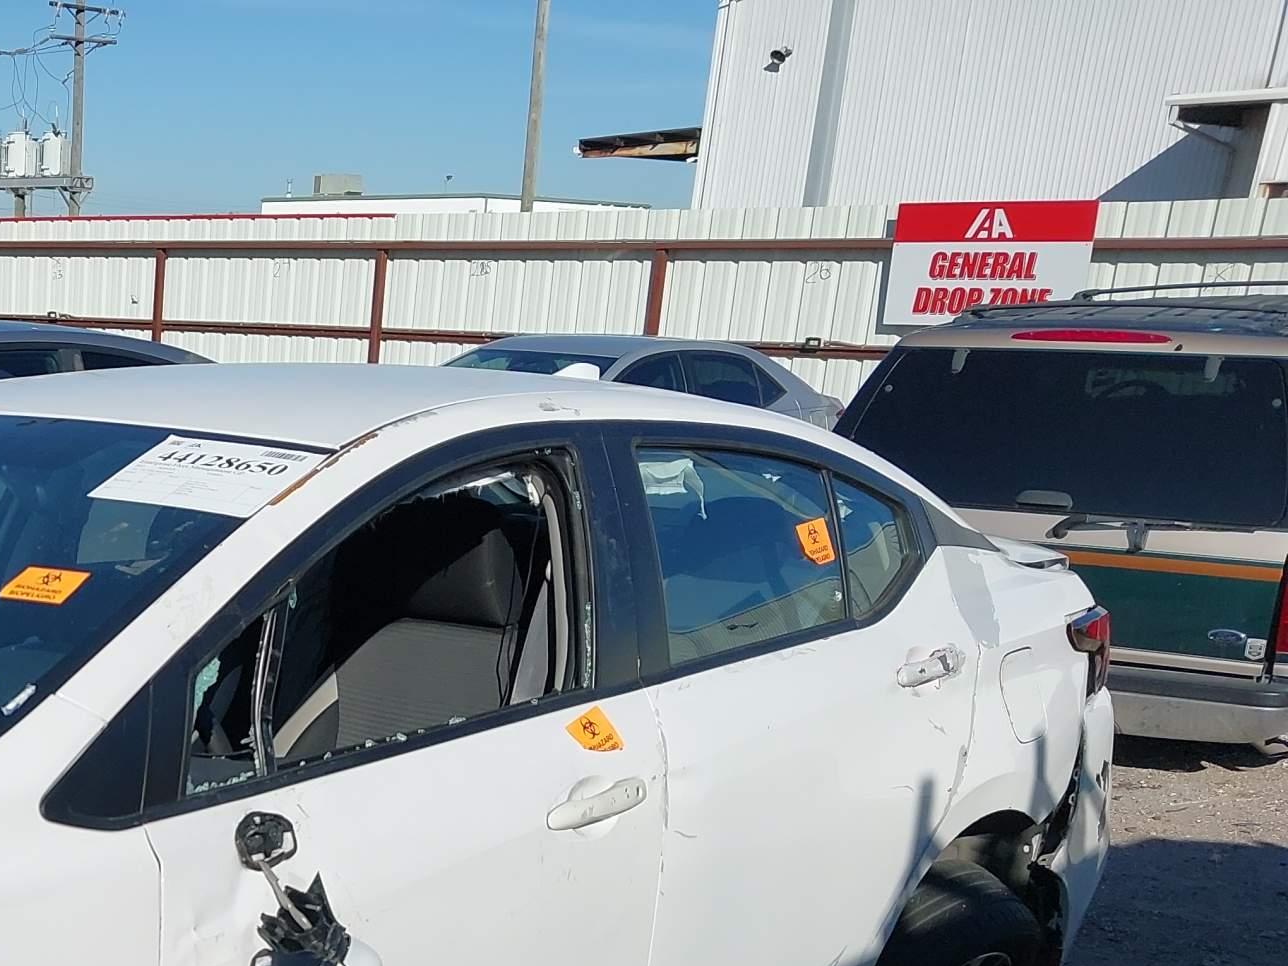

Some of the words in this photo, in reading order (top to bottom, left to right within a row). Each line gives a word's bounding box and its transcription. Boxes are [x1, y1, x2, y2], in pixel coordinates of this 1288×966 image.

[929, 251, 1038, 280] GENERAL
[913, 287, 984, 315] DROP
[158, 450, 289, 476] 44128650
